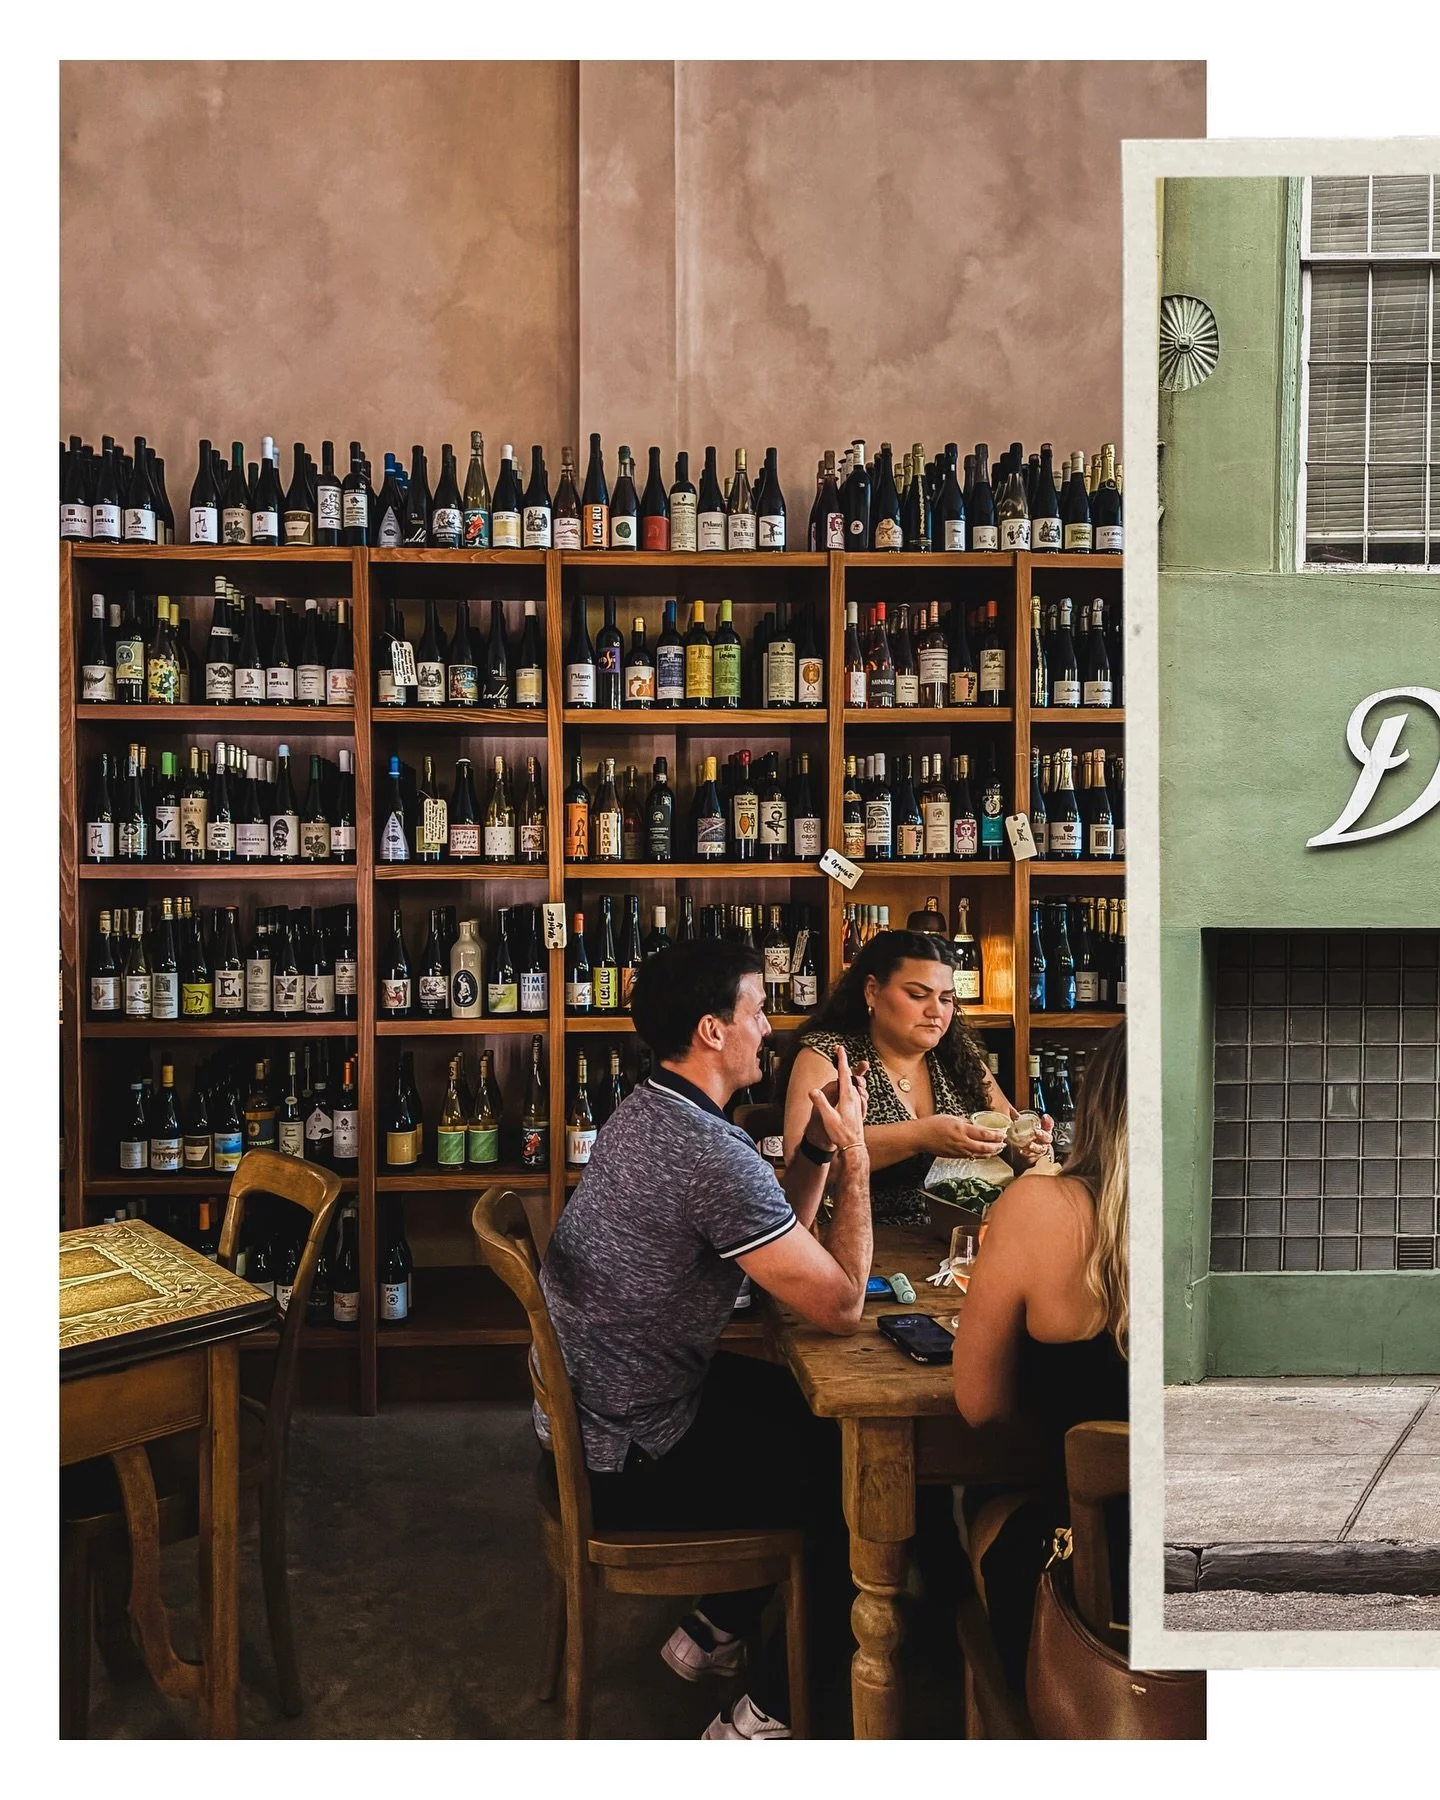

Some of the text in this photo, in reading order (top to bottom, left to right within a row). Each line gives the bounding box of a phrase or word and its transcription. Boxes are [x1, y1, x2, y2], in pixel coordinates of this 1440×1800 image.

[831, 859, 855, 880] ORANGE
[547, 909, 556, 940] ORANGE
[522, 976, 545, 984] TIME
[522, 984, 546, 992] TIME
